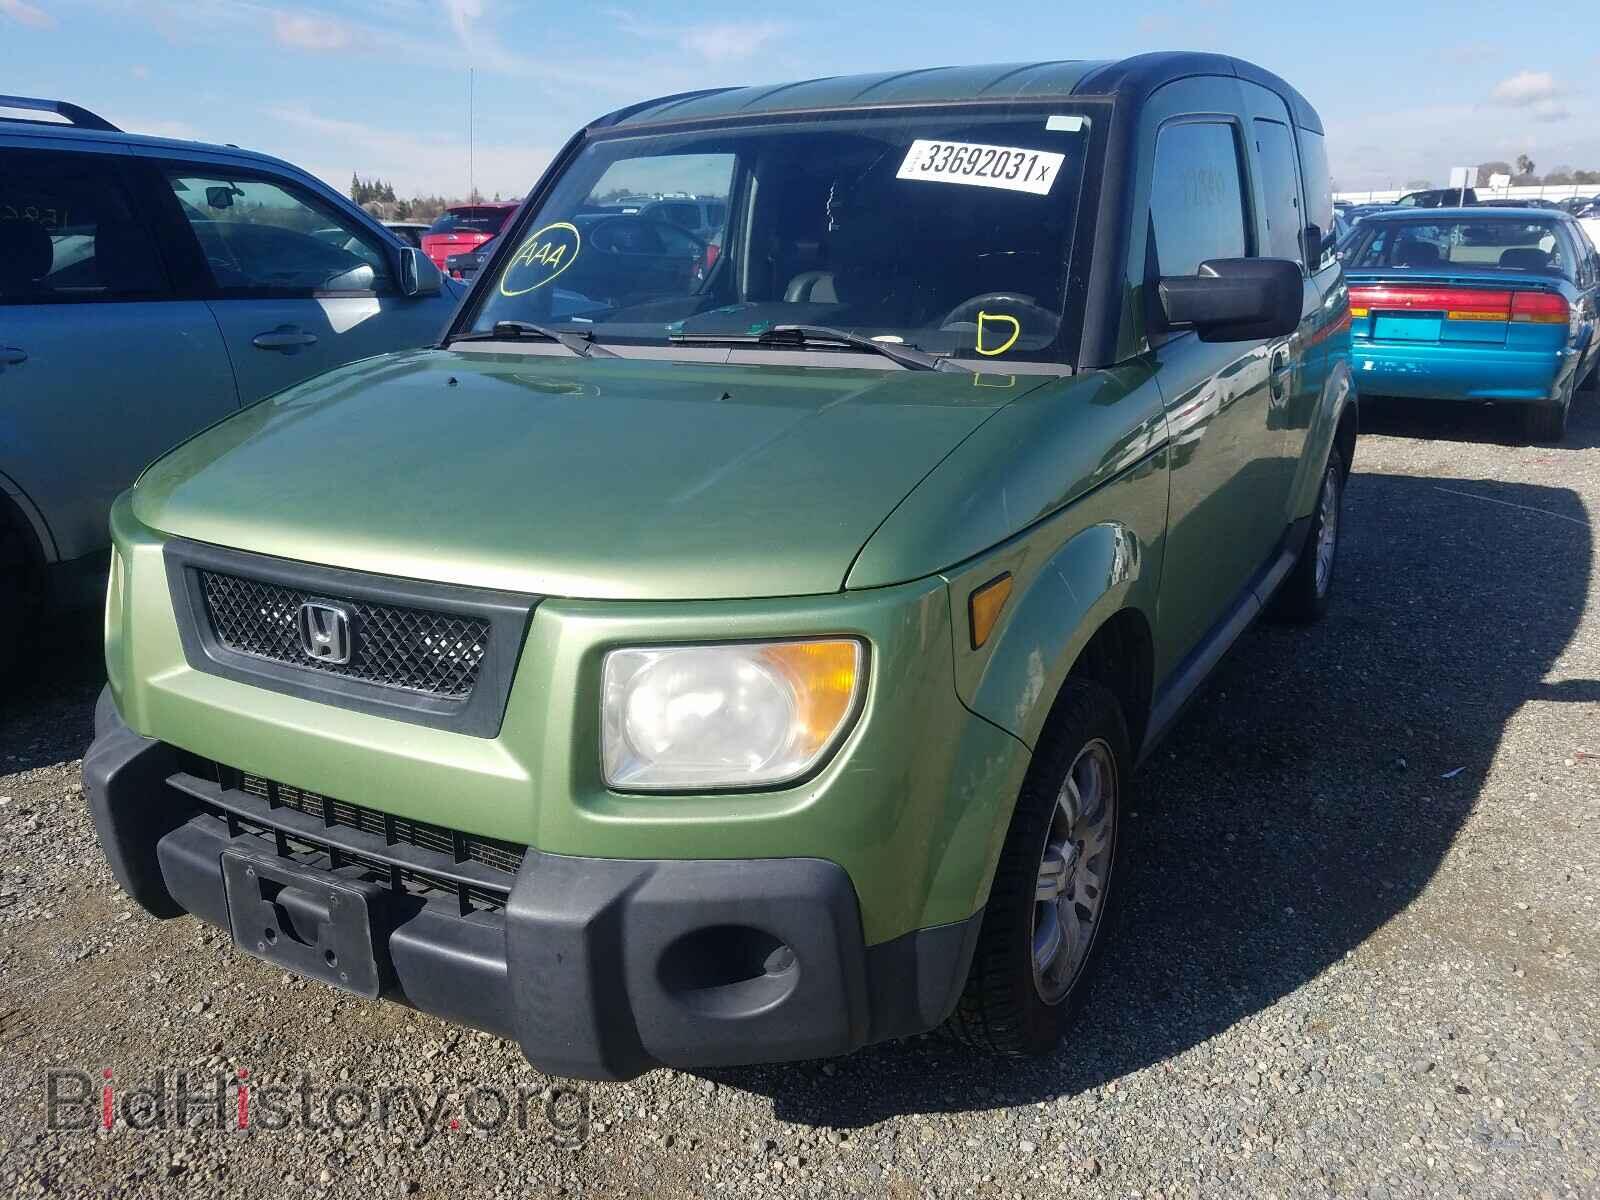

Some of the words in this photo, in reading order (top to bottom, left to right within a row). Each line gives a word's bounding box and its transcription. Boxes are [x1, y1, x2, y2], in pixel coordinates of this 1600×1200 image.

[920, 143, 1039, 182] 33692031
[513, 242, 567, 269] AAA
[976, 310, 1020, 356] D
